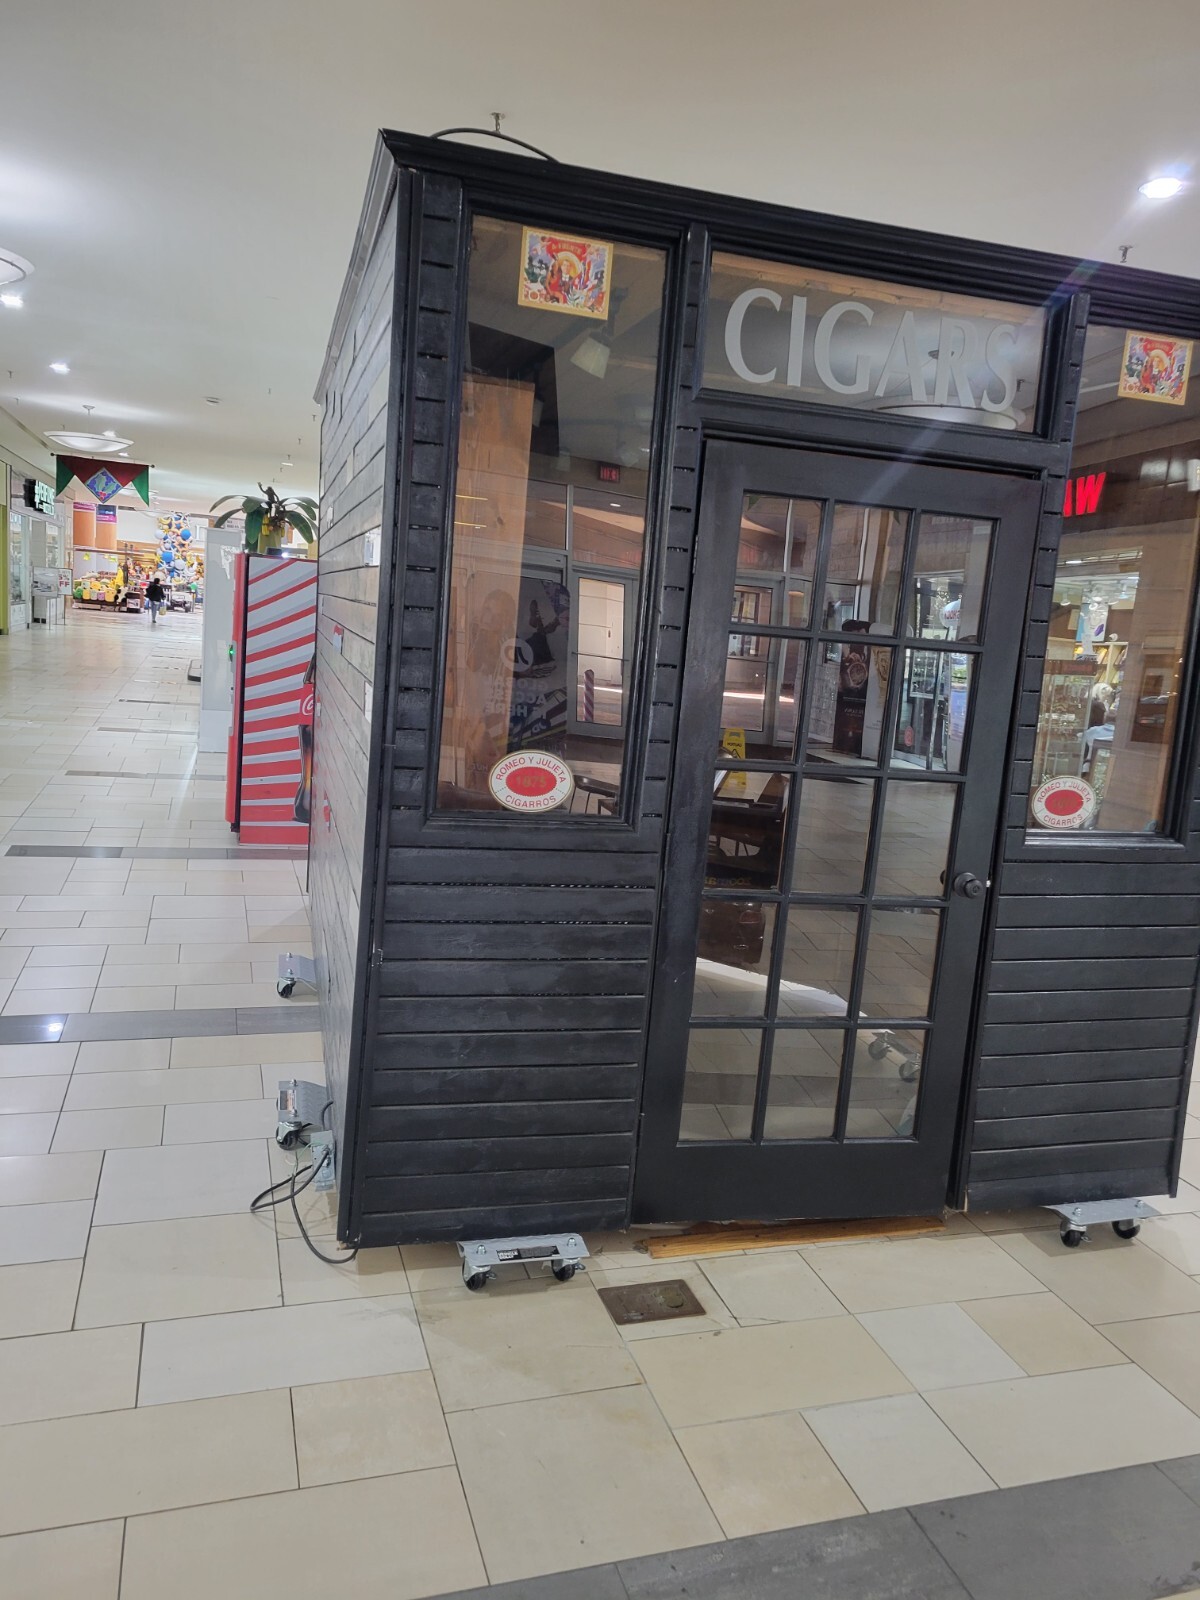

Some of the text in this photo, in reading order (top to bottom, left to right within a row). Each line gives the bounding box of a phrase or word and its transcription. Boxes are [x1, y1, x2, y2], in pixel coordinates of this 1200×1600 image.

[725, 287, 1020, 413] CIGARS
[496, 756, 567, 783] ROMEO Y JULIETA
[505, 795, 556, 808] CIGARROS
[1037, 781, 1061, 803] ROMEO
[1068, 781, 1092, 803] JULIETA
[1043, 814, 1083, 826] CIGARROS
